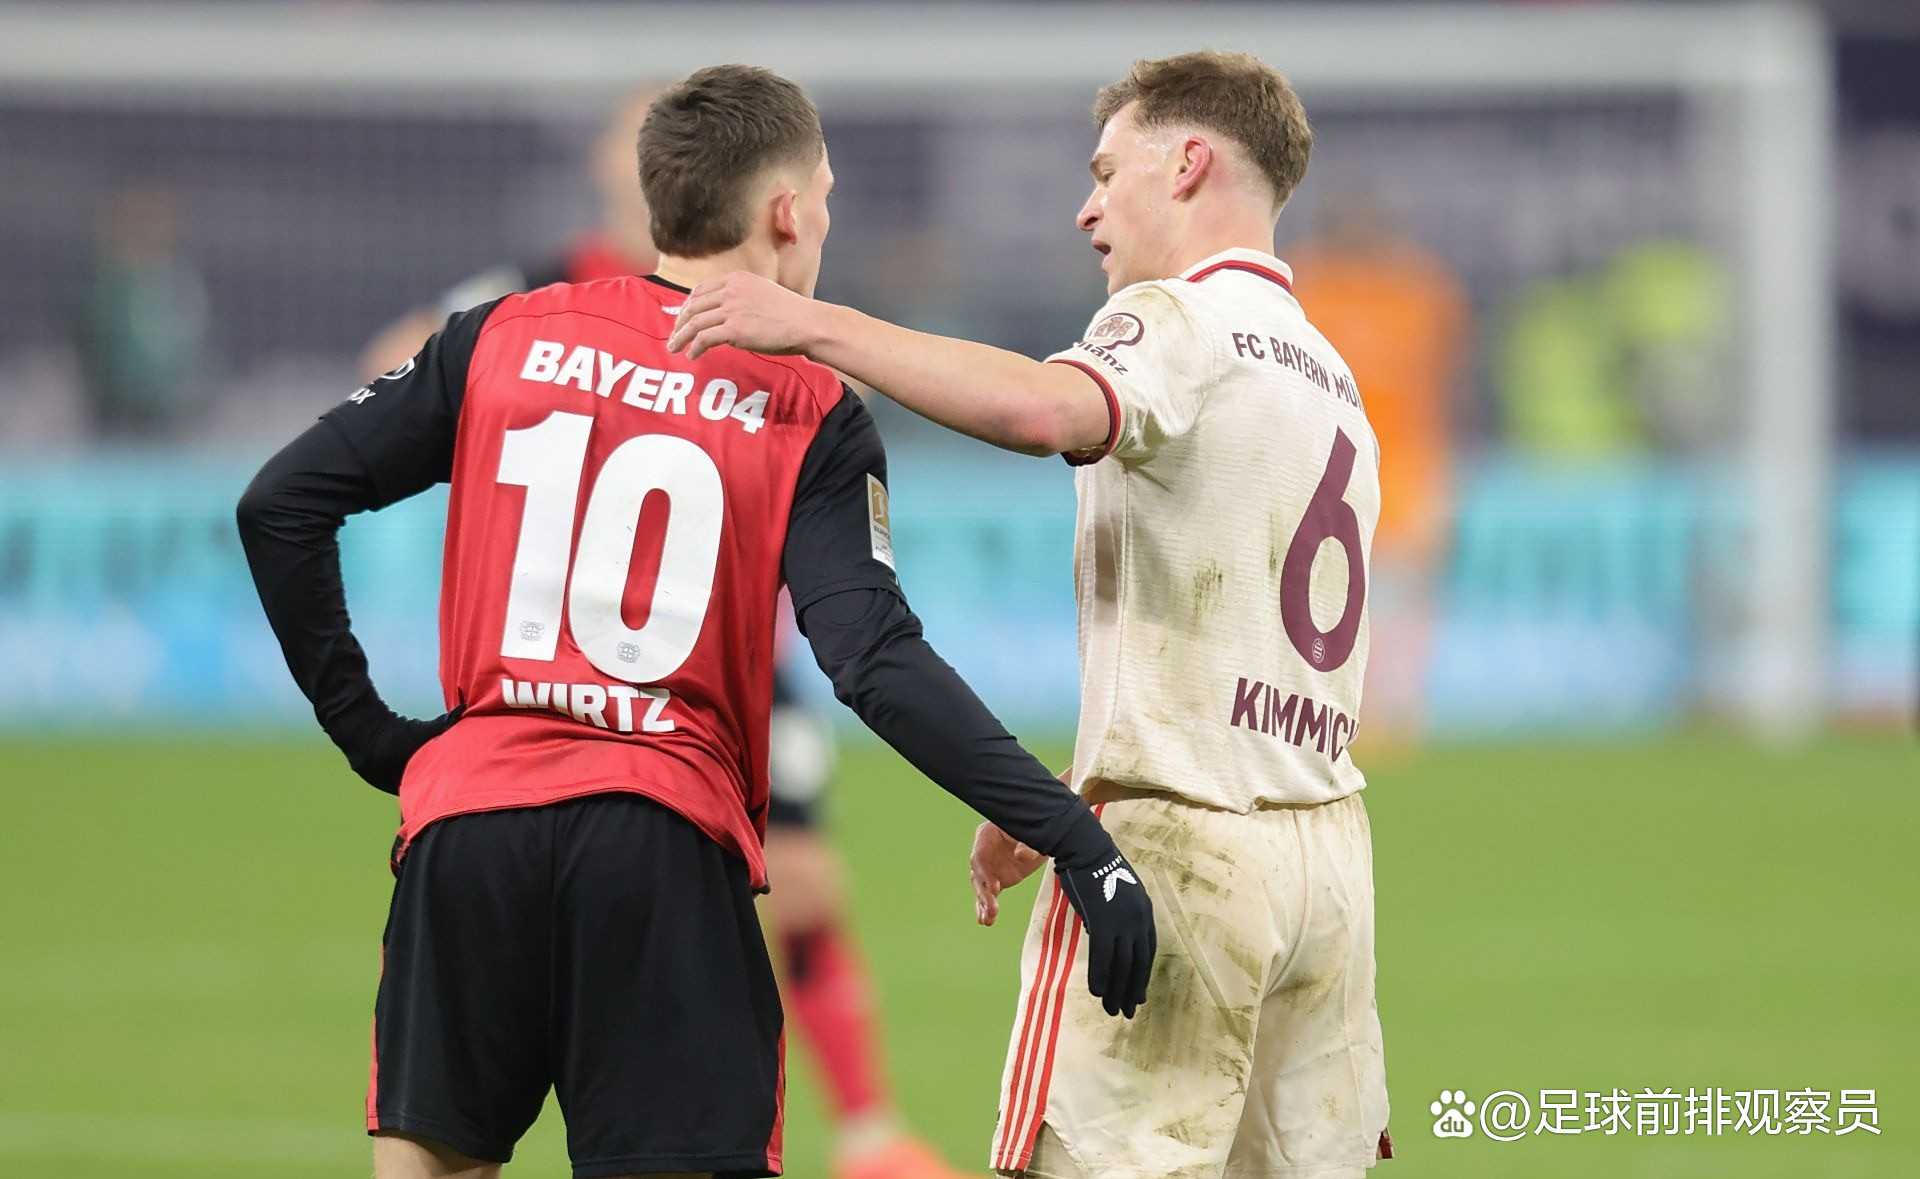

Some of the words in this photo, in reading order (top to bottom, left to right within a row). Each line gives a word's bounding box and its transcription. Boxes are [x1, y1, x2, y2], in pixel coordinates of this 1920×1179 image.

[520, 339, 695, 415] BAYER
[698, 378, 771, 434] 04
[1231, 332, 1265, 361] FC
[1269, 336, 1330, 393] BAYERN
[496, 410, 724, 683] 10
[1279, 425, 1366, 673] 6
[502, 678, 675, 732] WIRTZ
